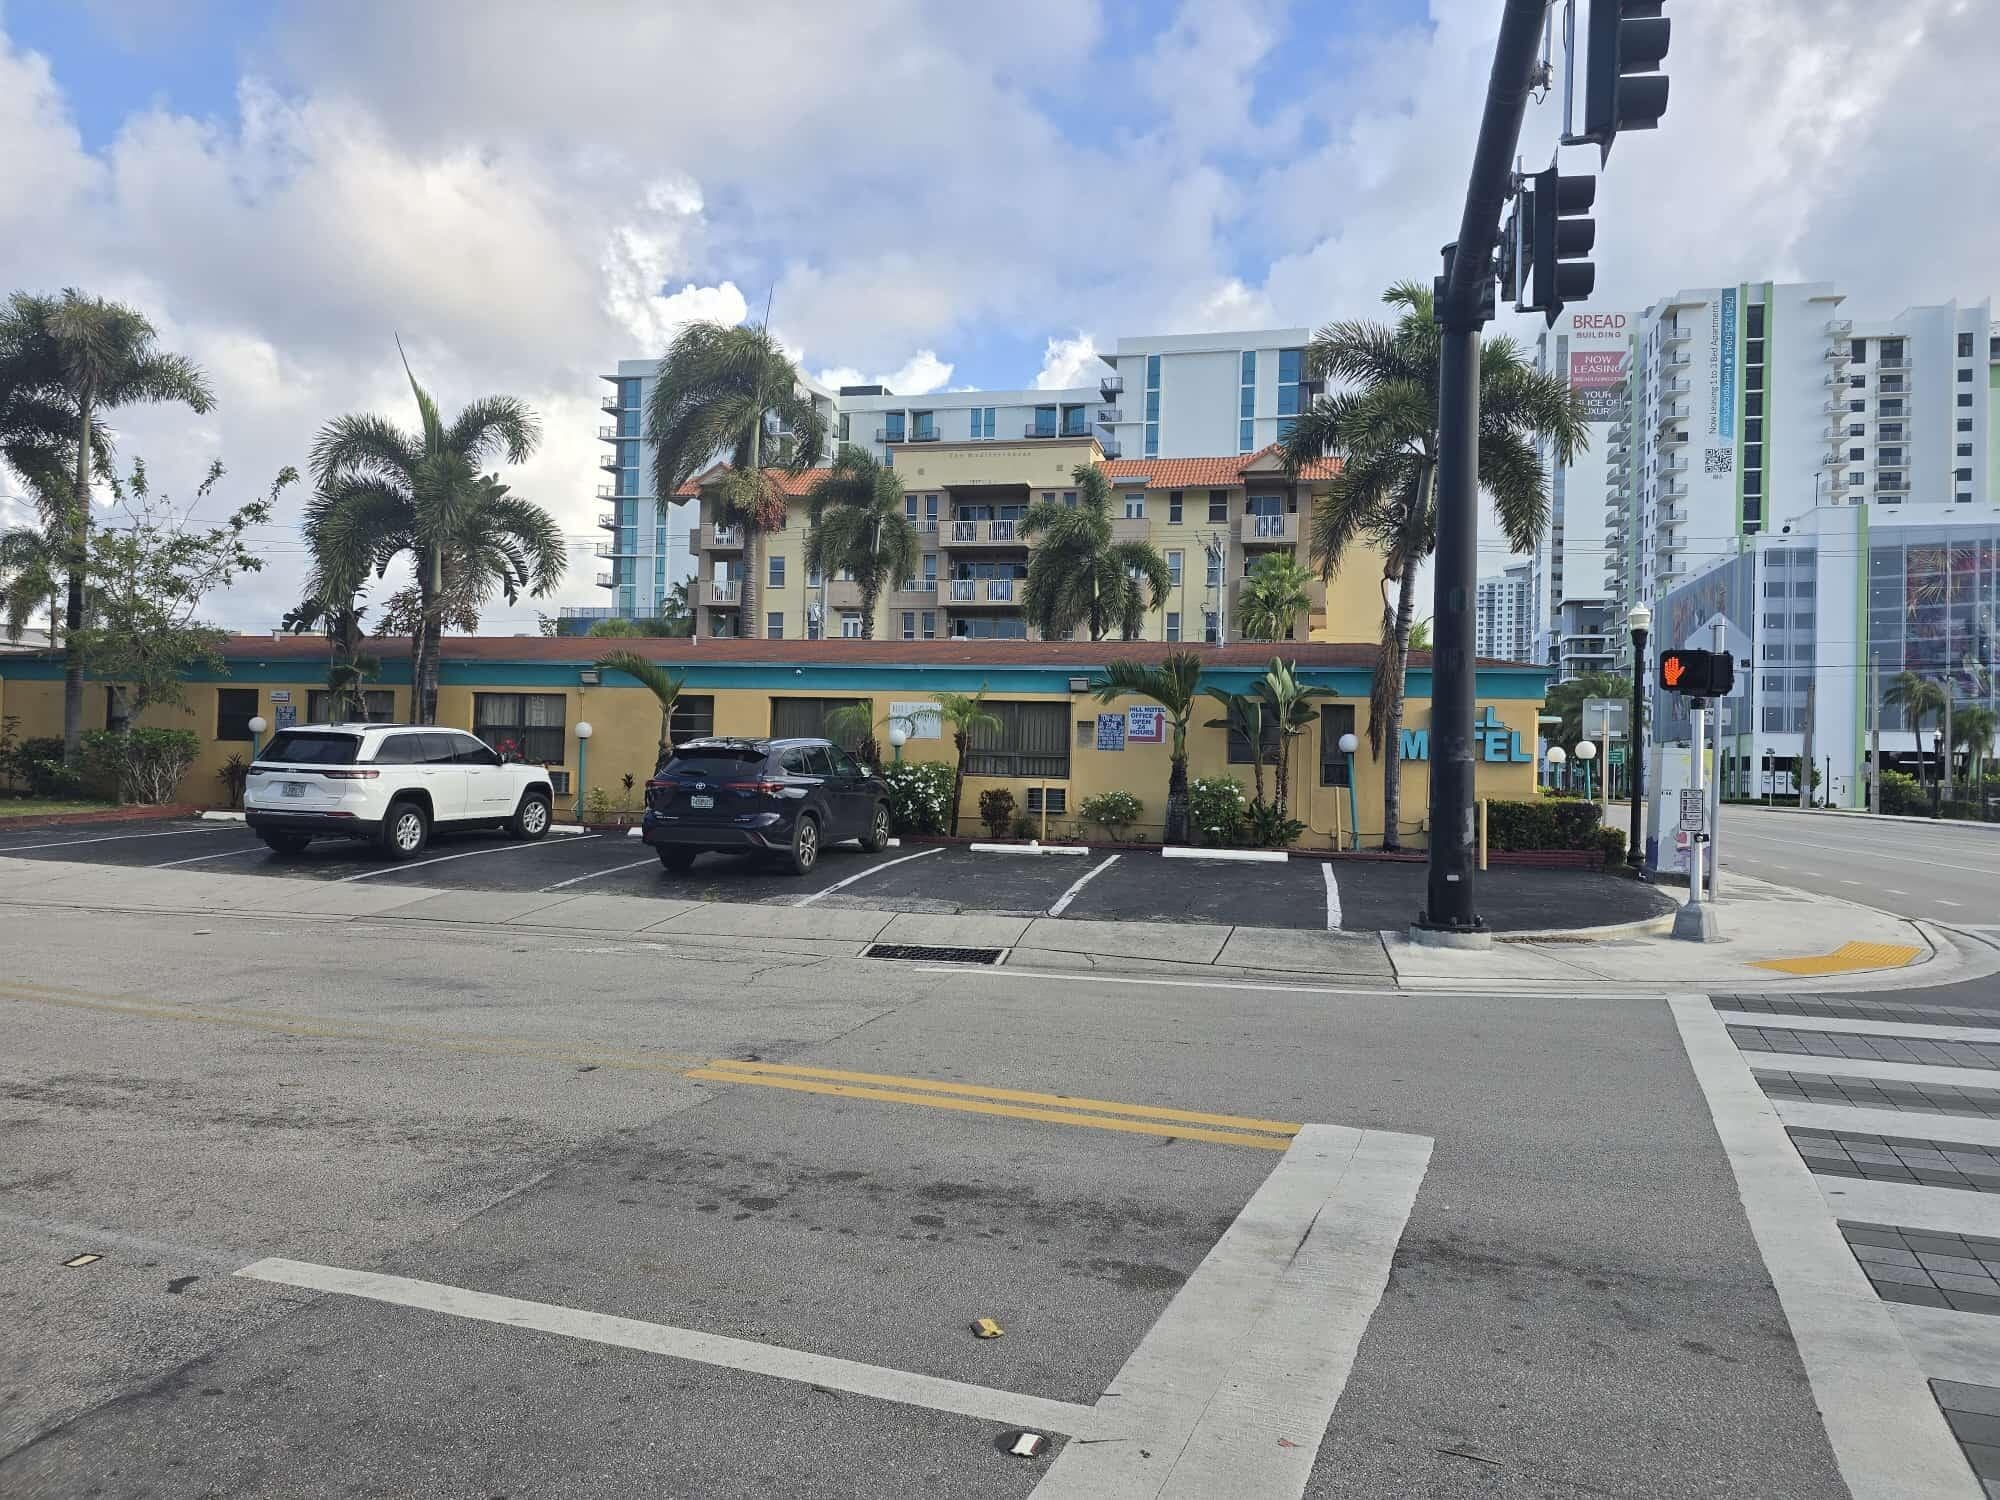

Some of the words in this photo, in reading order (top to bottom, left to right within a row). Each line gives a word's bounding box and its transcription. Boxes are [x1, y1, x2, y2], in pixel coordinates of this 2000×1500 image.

[1573, 314, 1626, 329] BREAD
[1576, 331, 1622, 339] BUILDING
[1585, 355, 1611, 364] NOW
[1710, 347, 1718, 362] Bed
[1584, 390, 1612, 399] YOUR
[1709, 386, 1719, 415] Leasing
[1584, 407, 1610, 415] UXUR
[1709, 416, 1717, 434] Now
[1400, 728, 1533, 762] MEL
